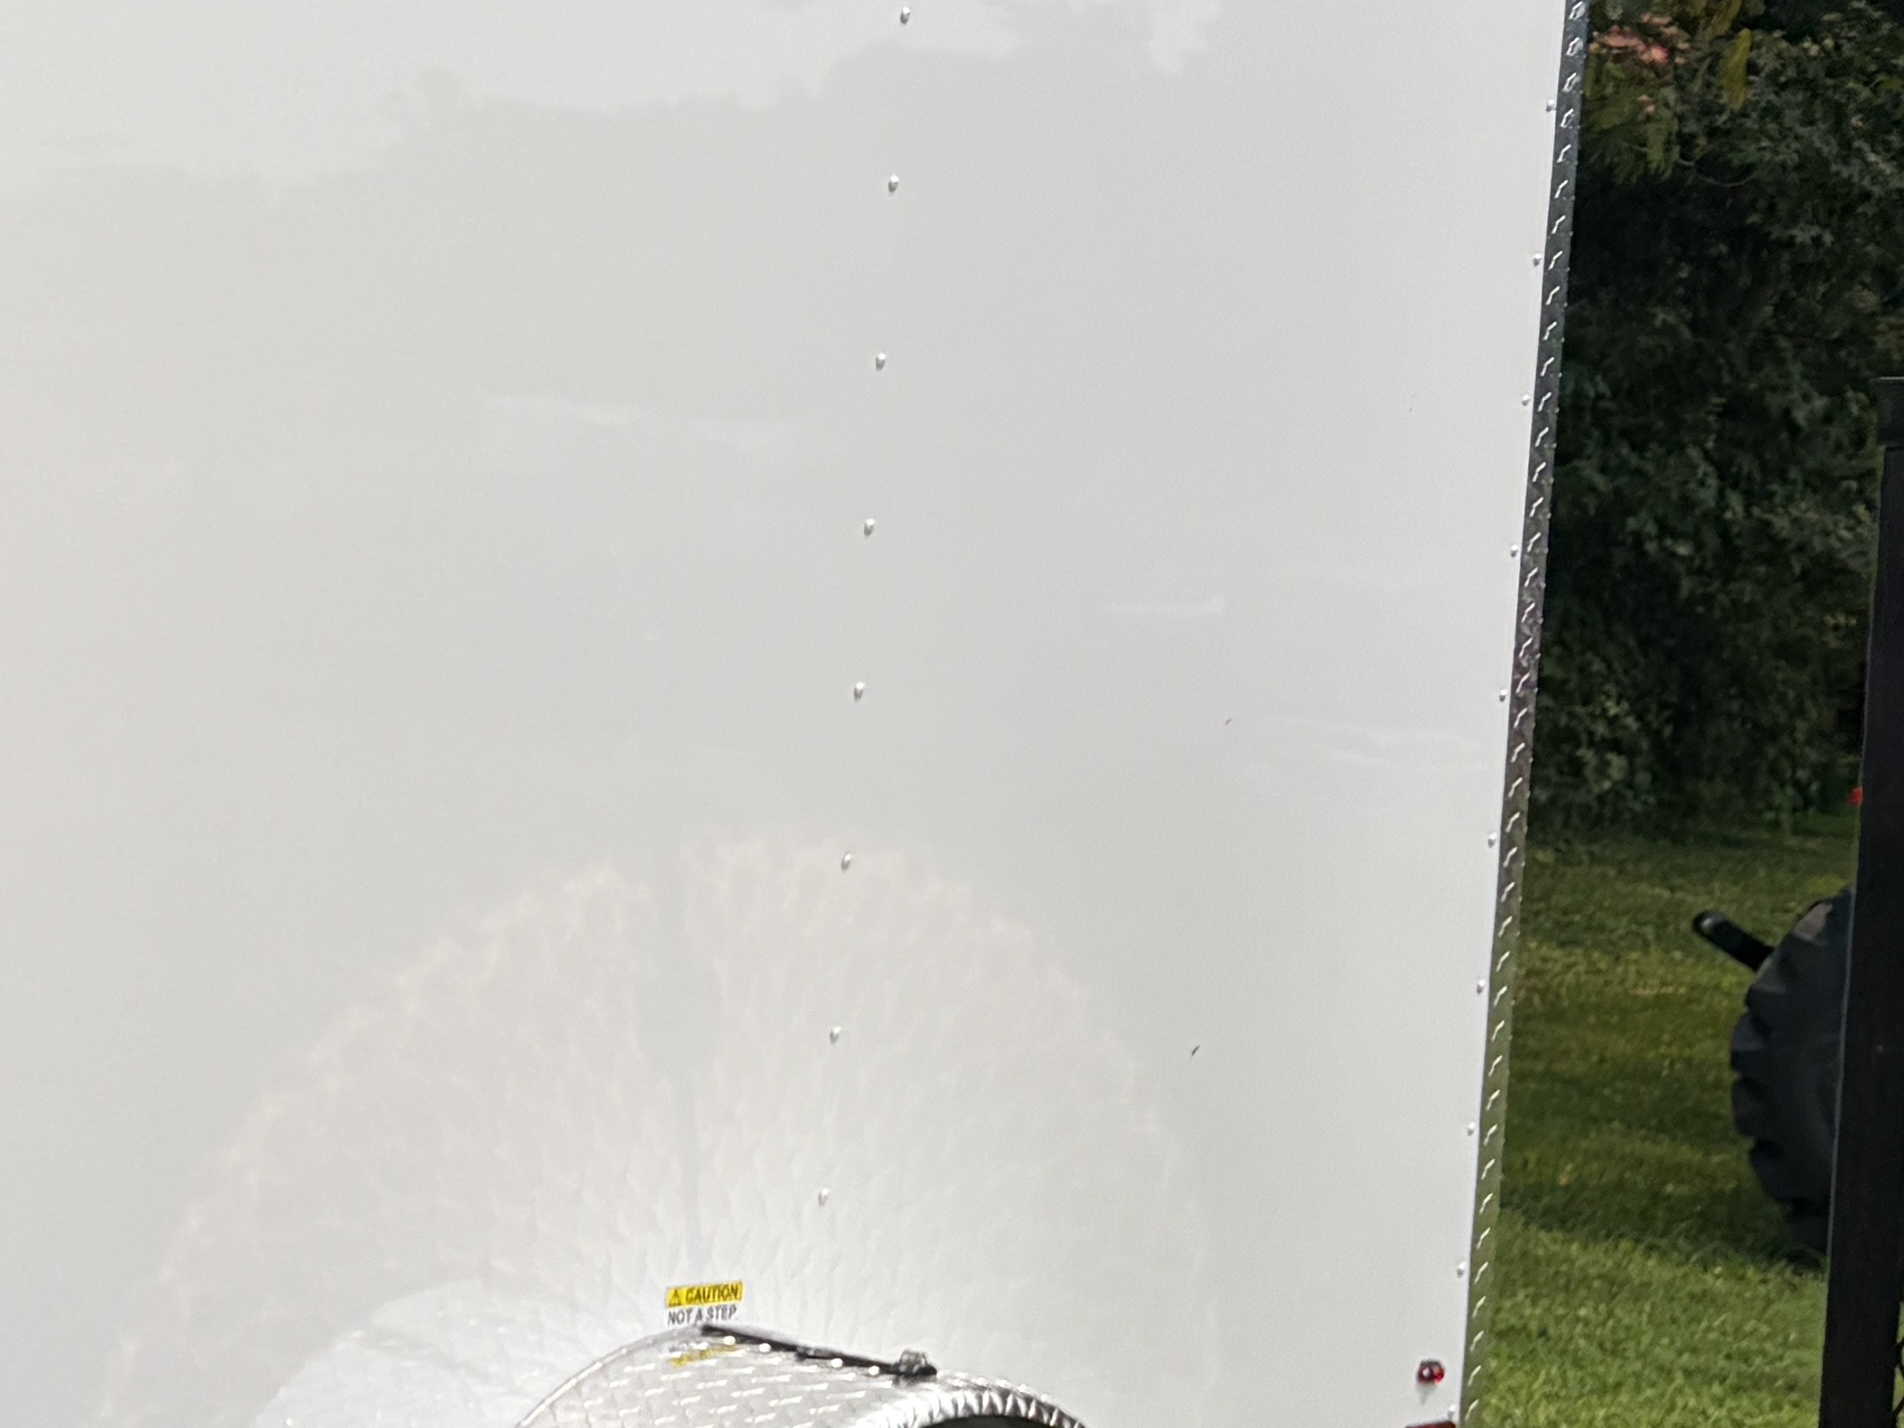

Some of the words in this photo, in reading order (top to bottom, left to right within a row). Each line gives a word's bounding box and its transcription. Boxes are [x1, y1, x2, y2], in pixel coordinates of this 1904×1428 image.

[685, 1283, 739, 1304] CAUTION
[667, 1308, 693, 1326] NOT
[695, 1307, 703, 1321] A
[707, 1304, 737, 1321] STEP
